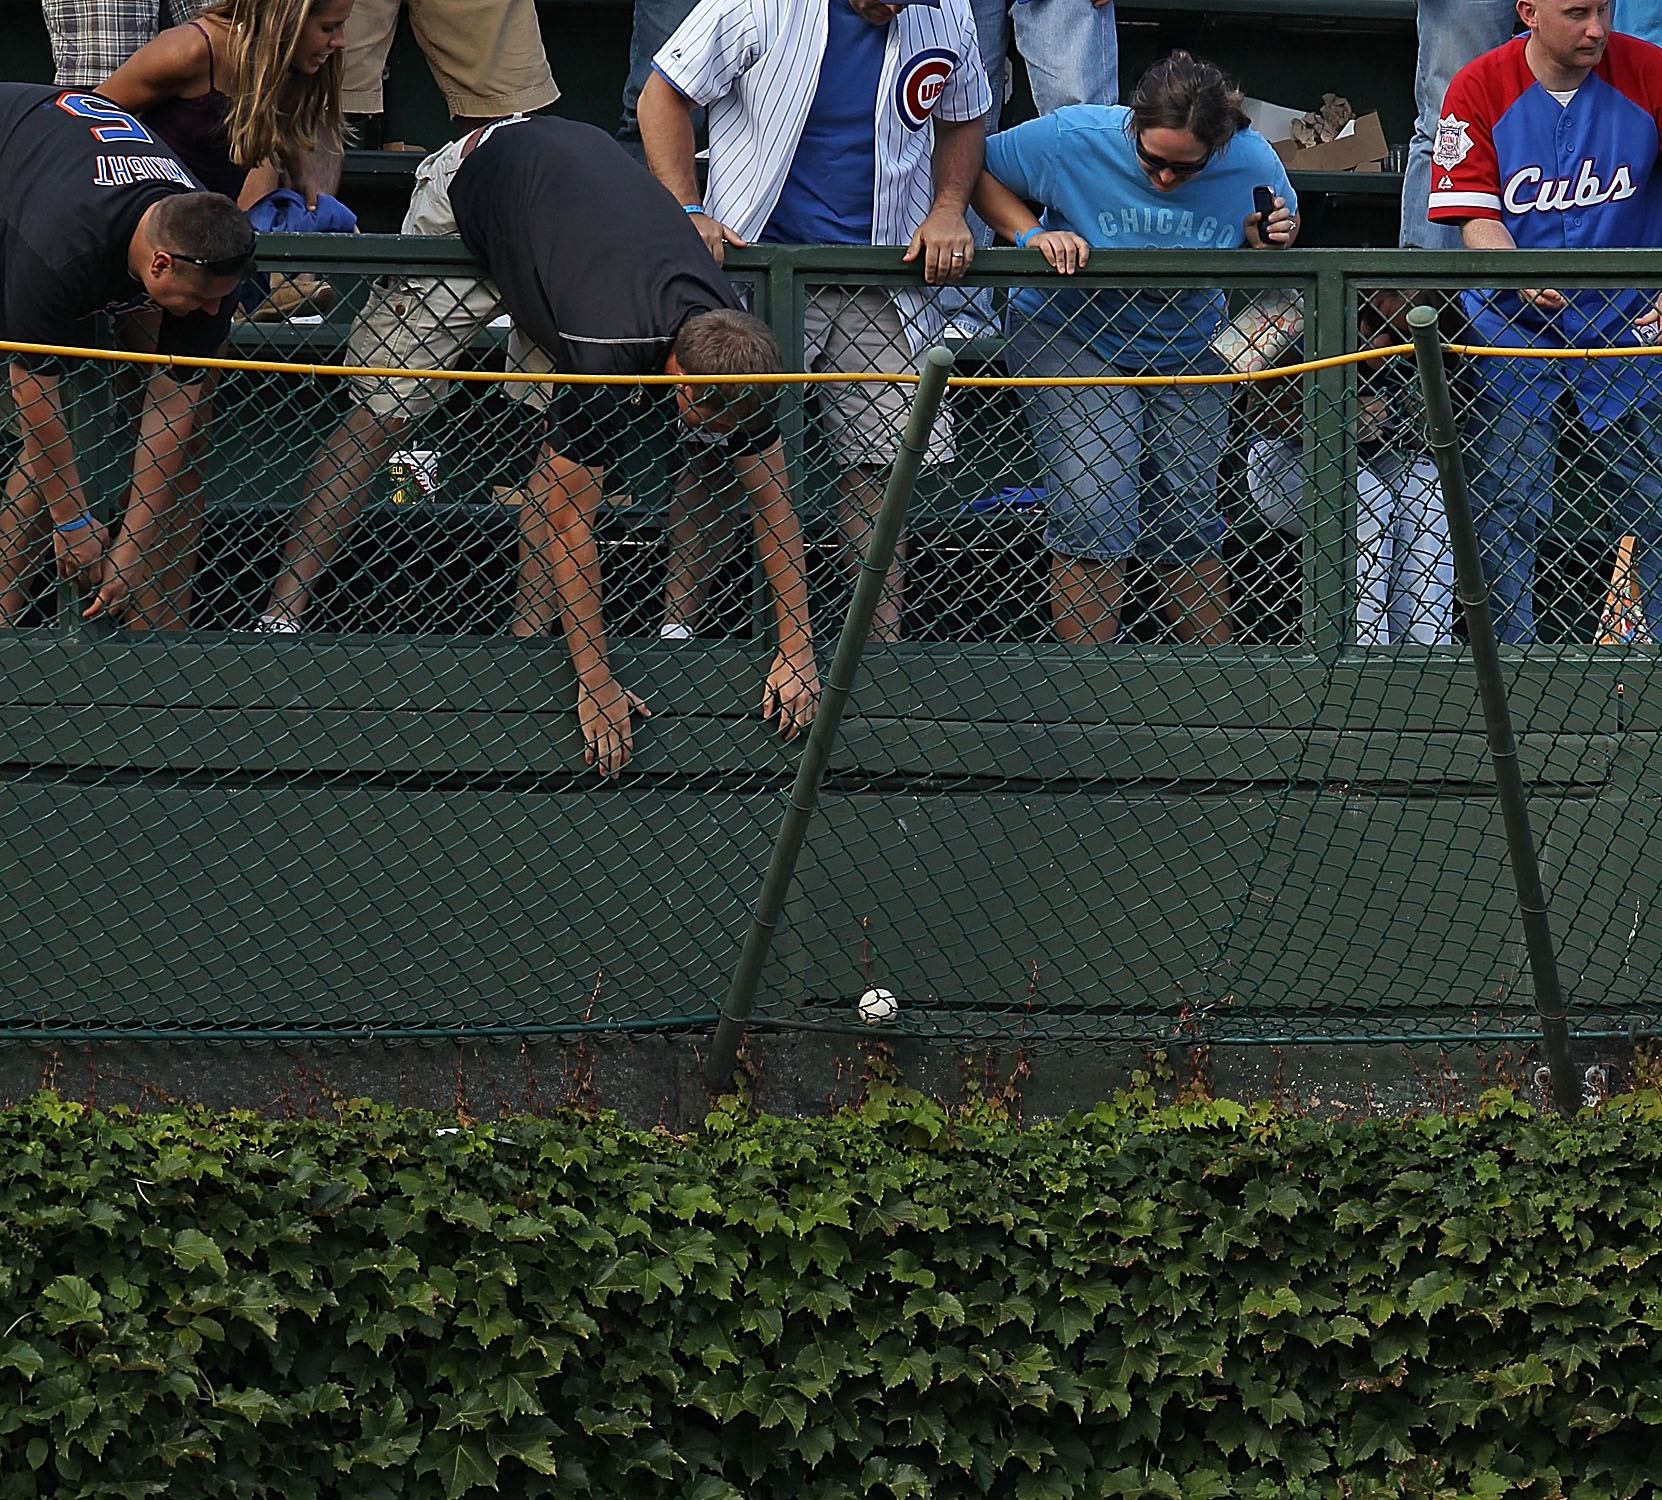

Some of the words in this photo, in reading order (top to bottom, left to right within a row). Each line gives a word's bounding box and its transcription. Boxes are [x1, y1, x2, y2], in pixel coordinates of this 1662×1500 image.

[56, 91, 154, 144] 5
[1503, 158, 1637, 214] Cubs
[1099, 207, 1236, 248] CHICAGO
